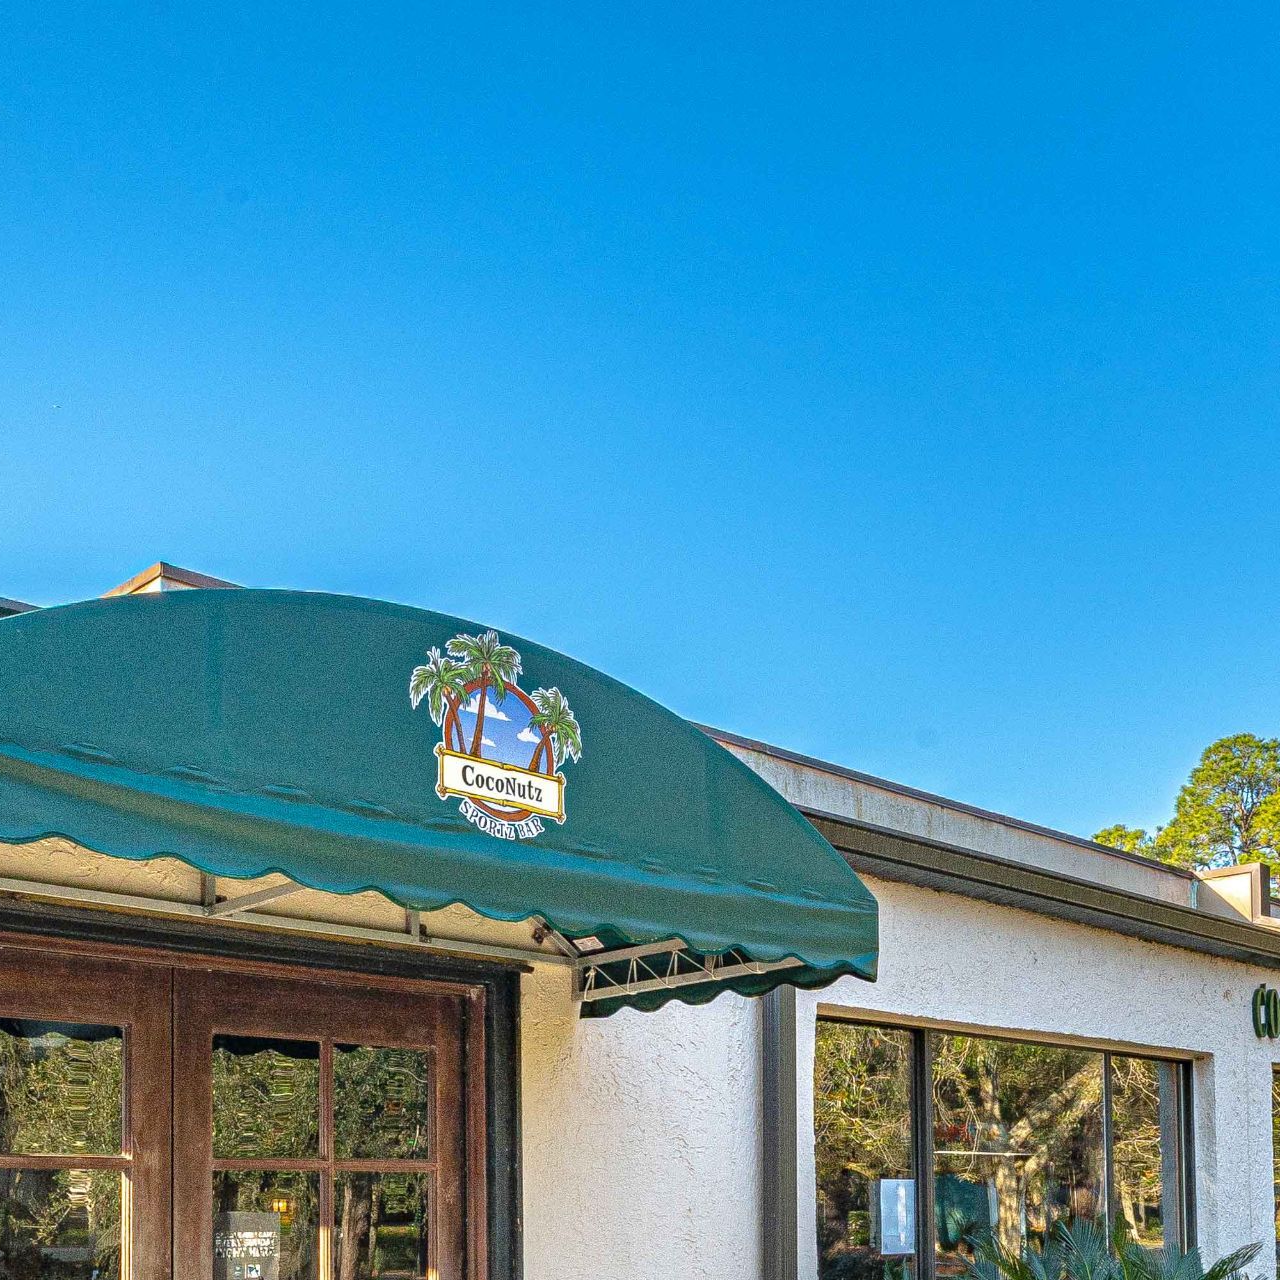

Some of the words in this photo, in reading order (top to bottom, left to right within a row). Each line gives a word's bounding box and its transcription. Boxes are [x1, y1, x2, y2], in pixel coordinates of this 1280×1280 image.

[461, 765, 543, 802] CocoNutz
[460, 800, 515, 839] SPORTZ
[517, 818, 544, 838] BAR
